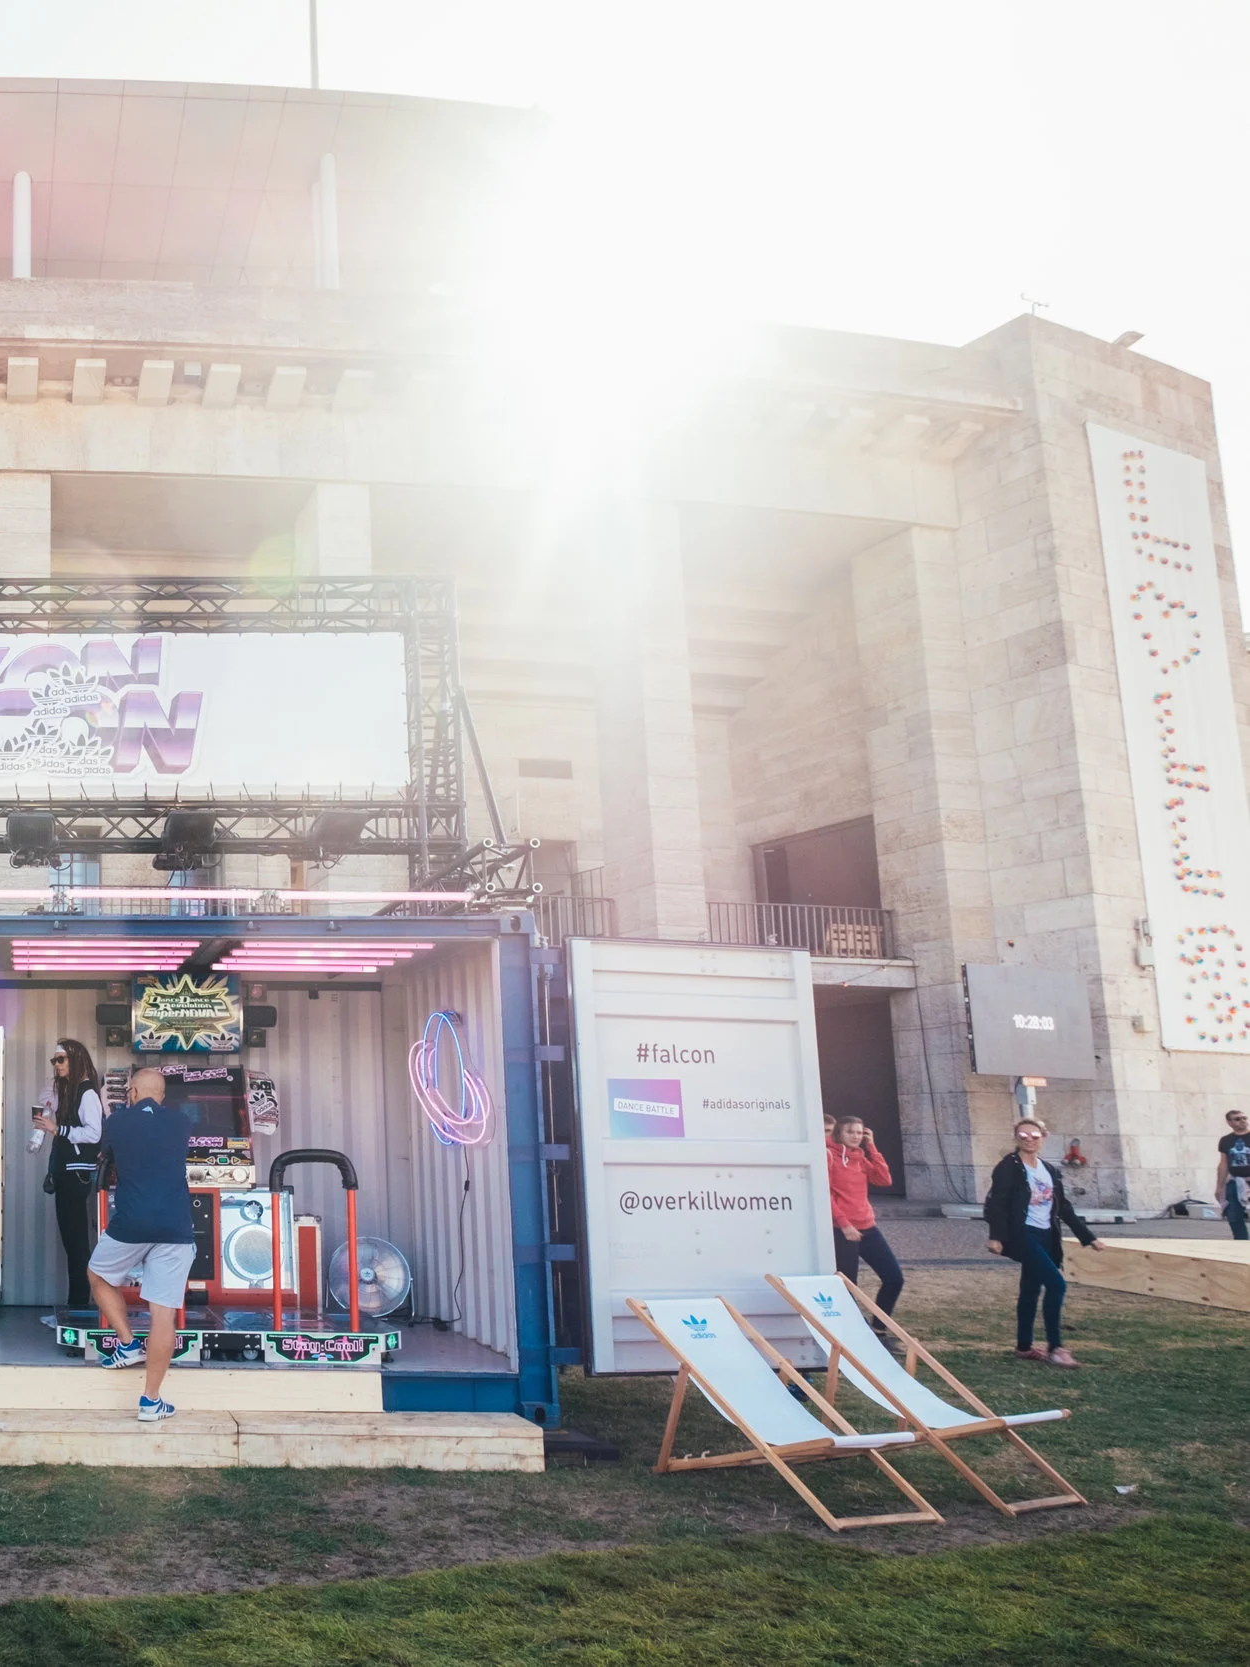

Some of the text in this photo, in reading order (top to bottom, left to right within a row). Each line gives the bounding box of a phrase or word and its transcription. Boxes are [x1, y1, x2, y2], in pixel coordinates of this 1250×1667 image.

[64, 692, 99, 704] adidas
[33, 706, 68, 717] adidas
[636, 1043, 716, 1064] #falcon
[617, 1101, 675, 1115] DANCE BATTLE
[702, 1098, 791, 1112] #adidasoriginals
[619, 1190, 793, 1215] @overkillwomen
